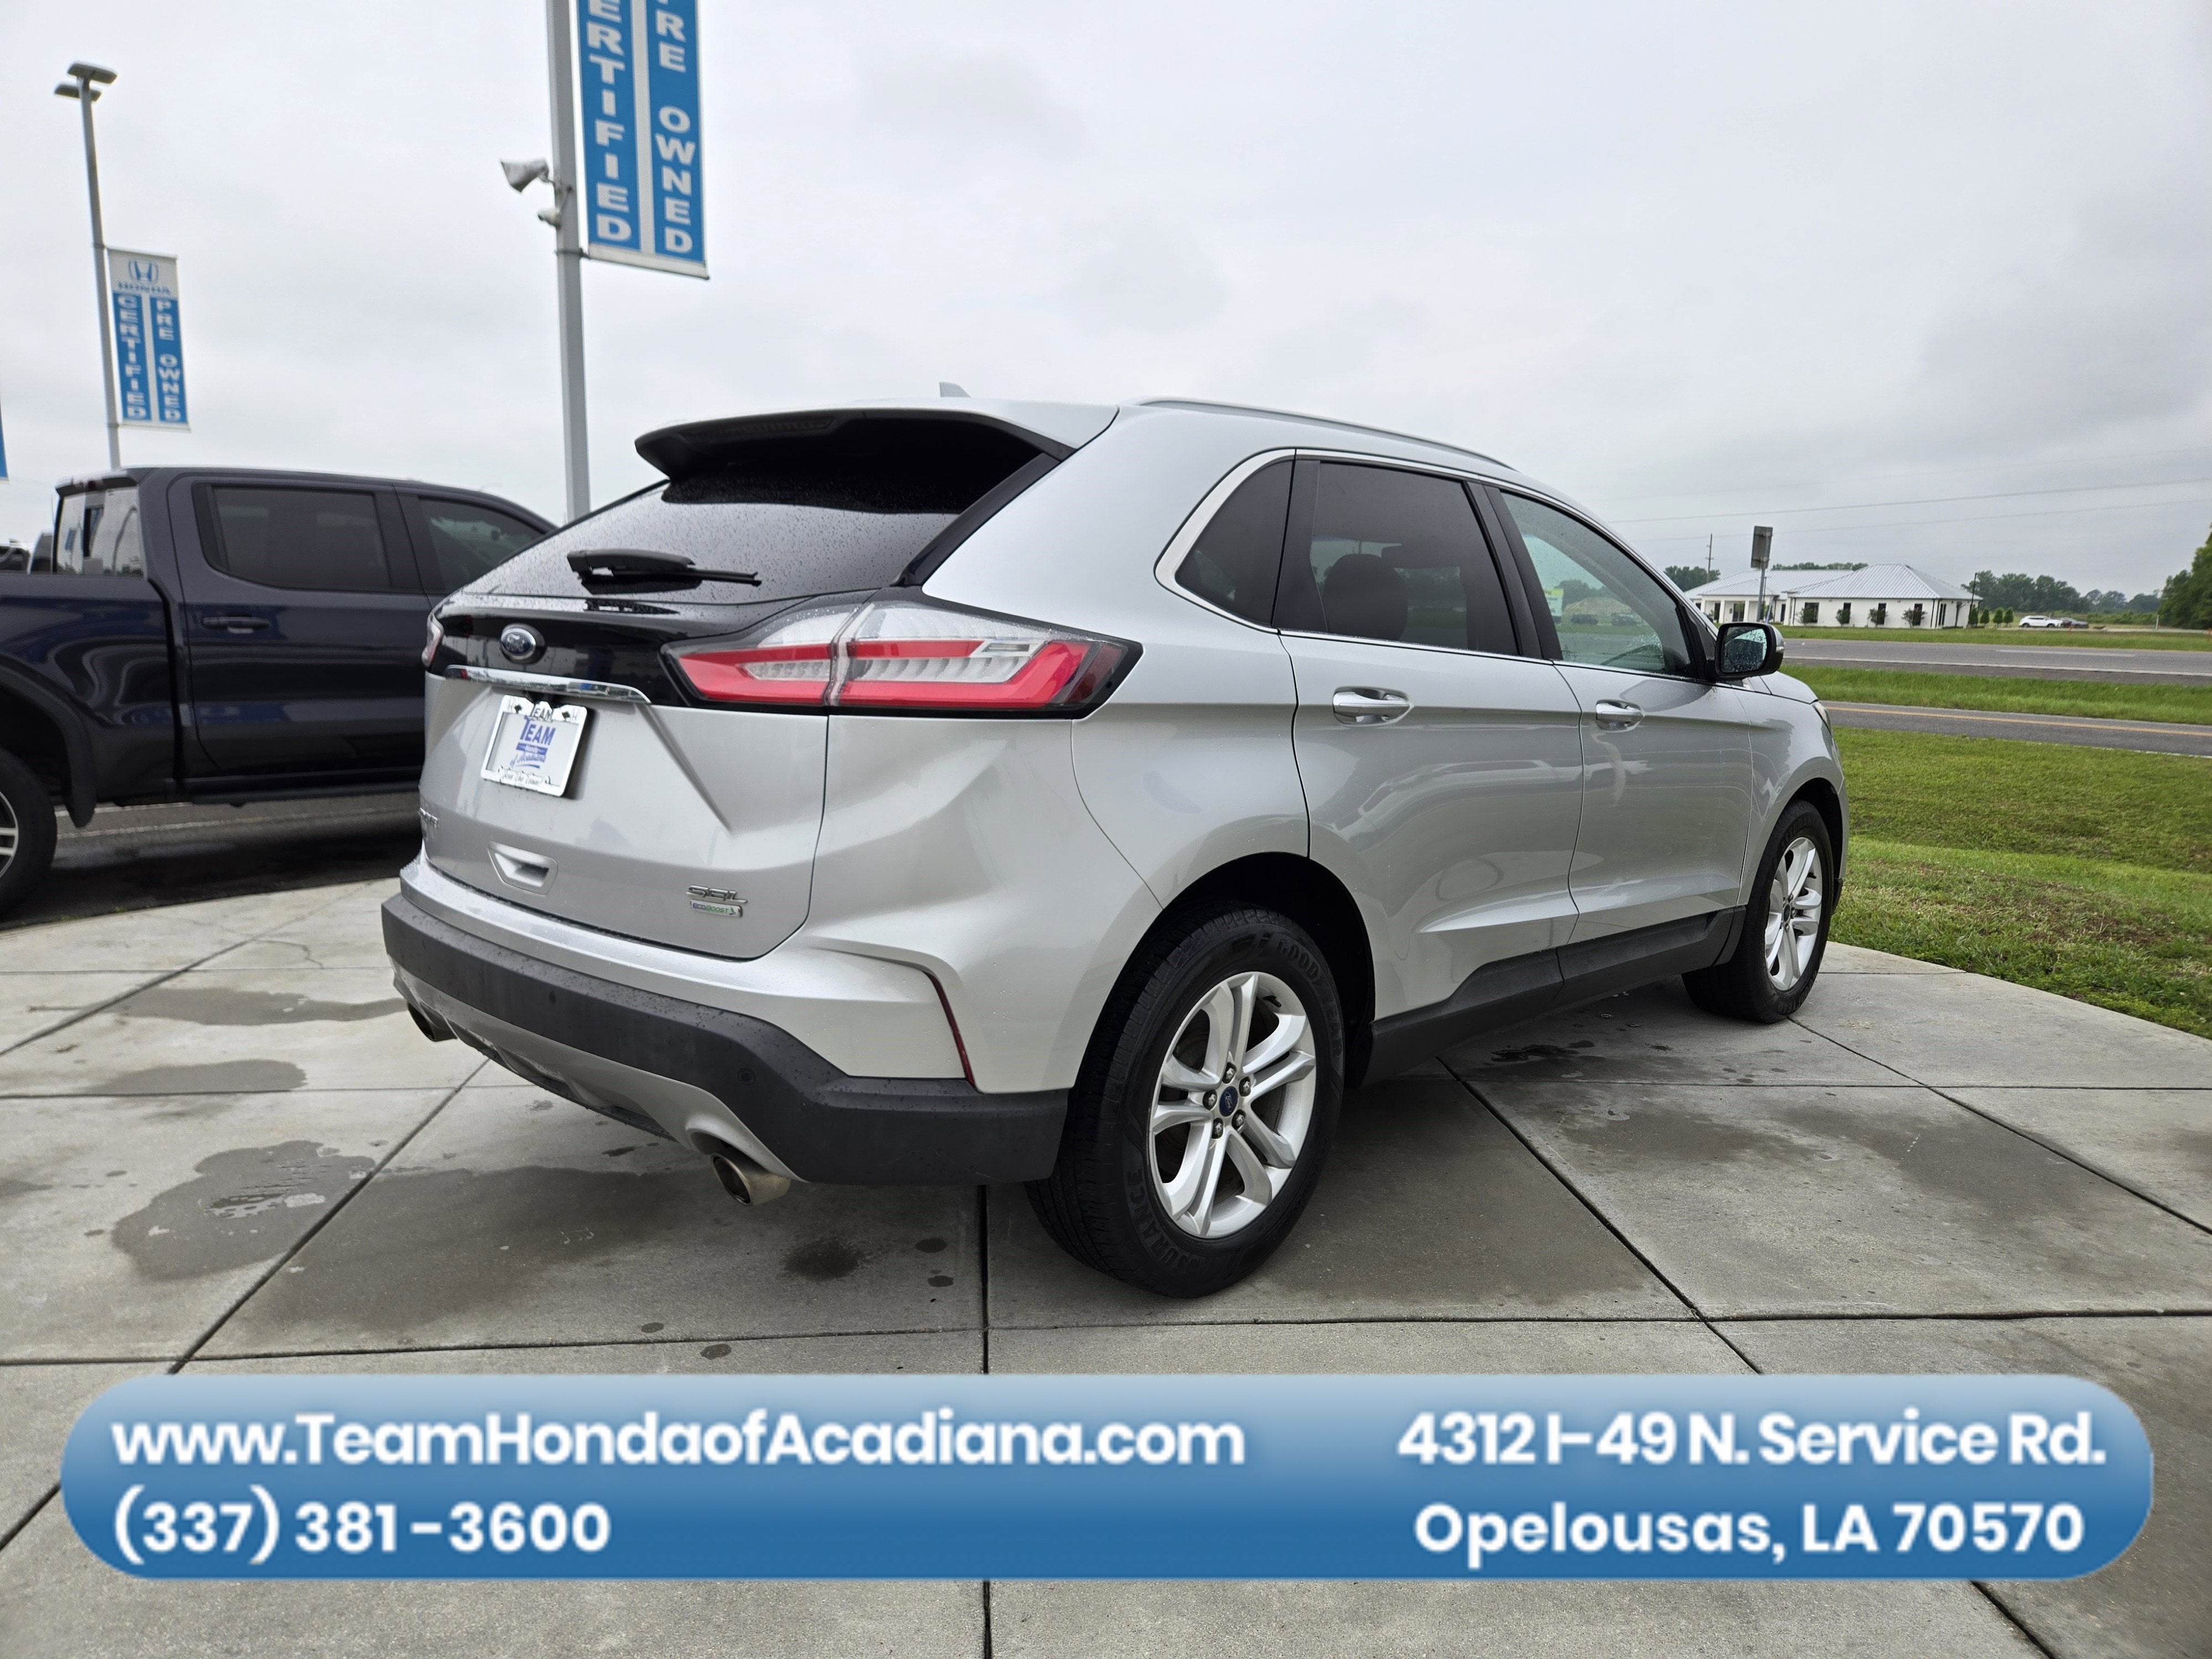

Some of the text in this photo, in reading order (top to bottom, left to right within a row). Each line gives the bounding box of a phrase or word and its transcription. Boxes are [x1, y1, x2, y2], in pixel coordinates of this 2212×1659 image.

[655, 0, 696, 254] RE OWNED
[118, 295, 147, 419] CERTIFIED
[156, 300, 181, 421] PRE OWNED
[520, 715, 556, 745] TEAM
